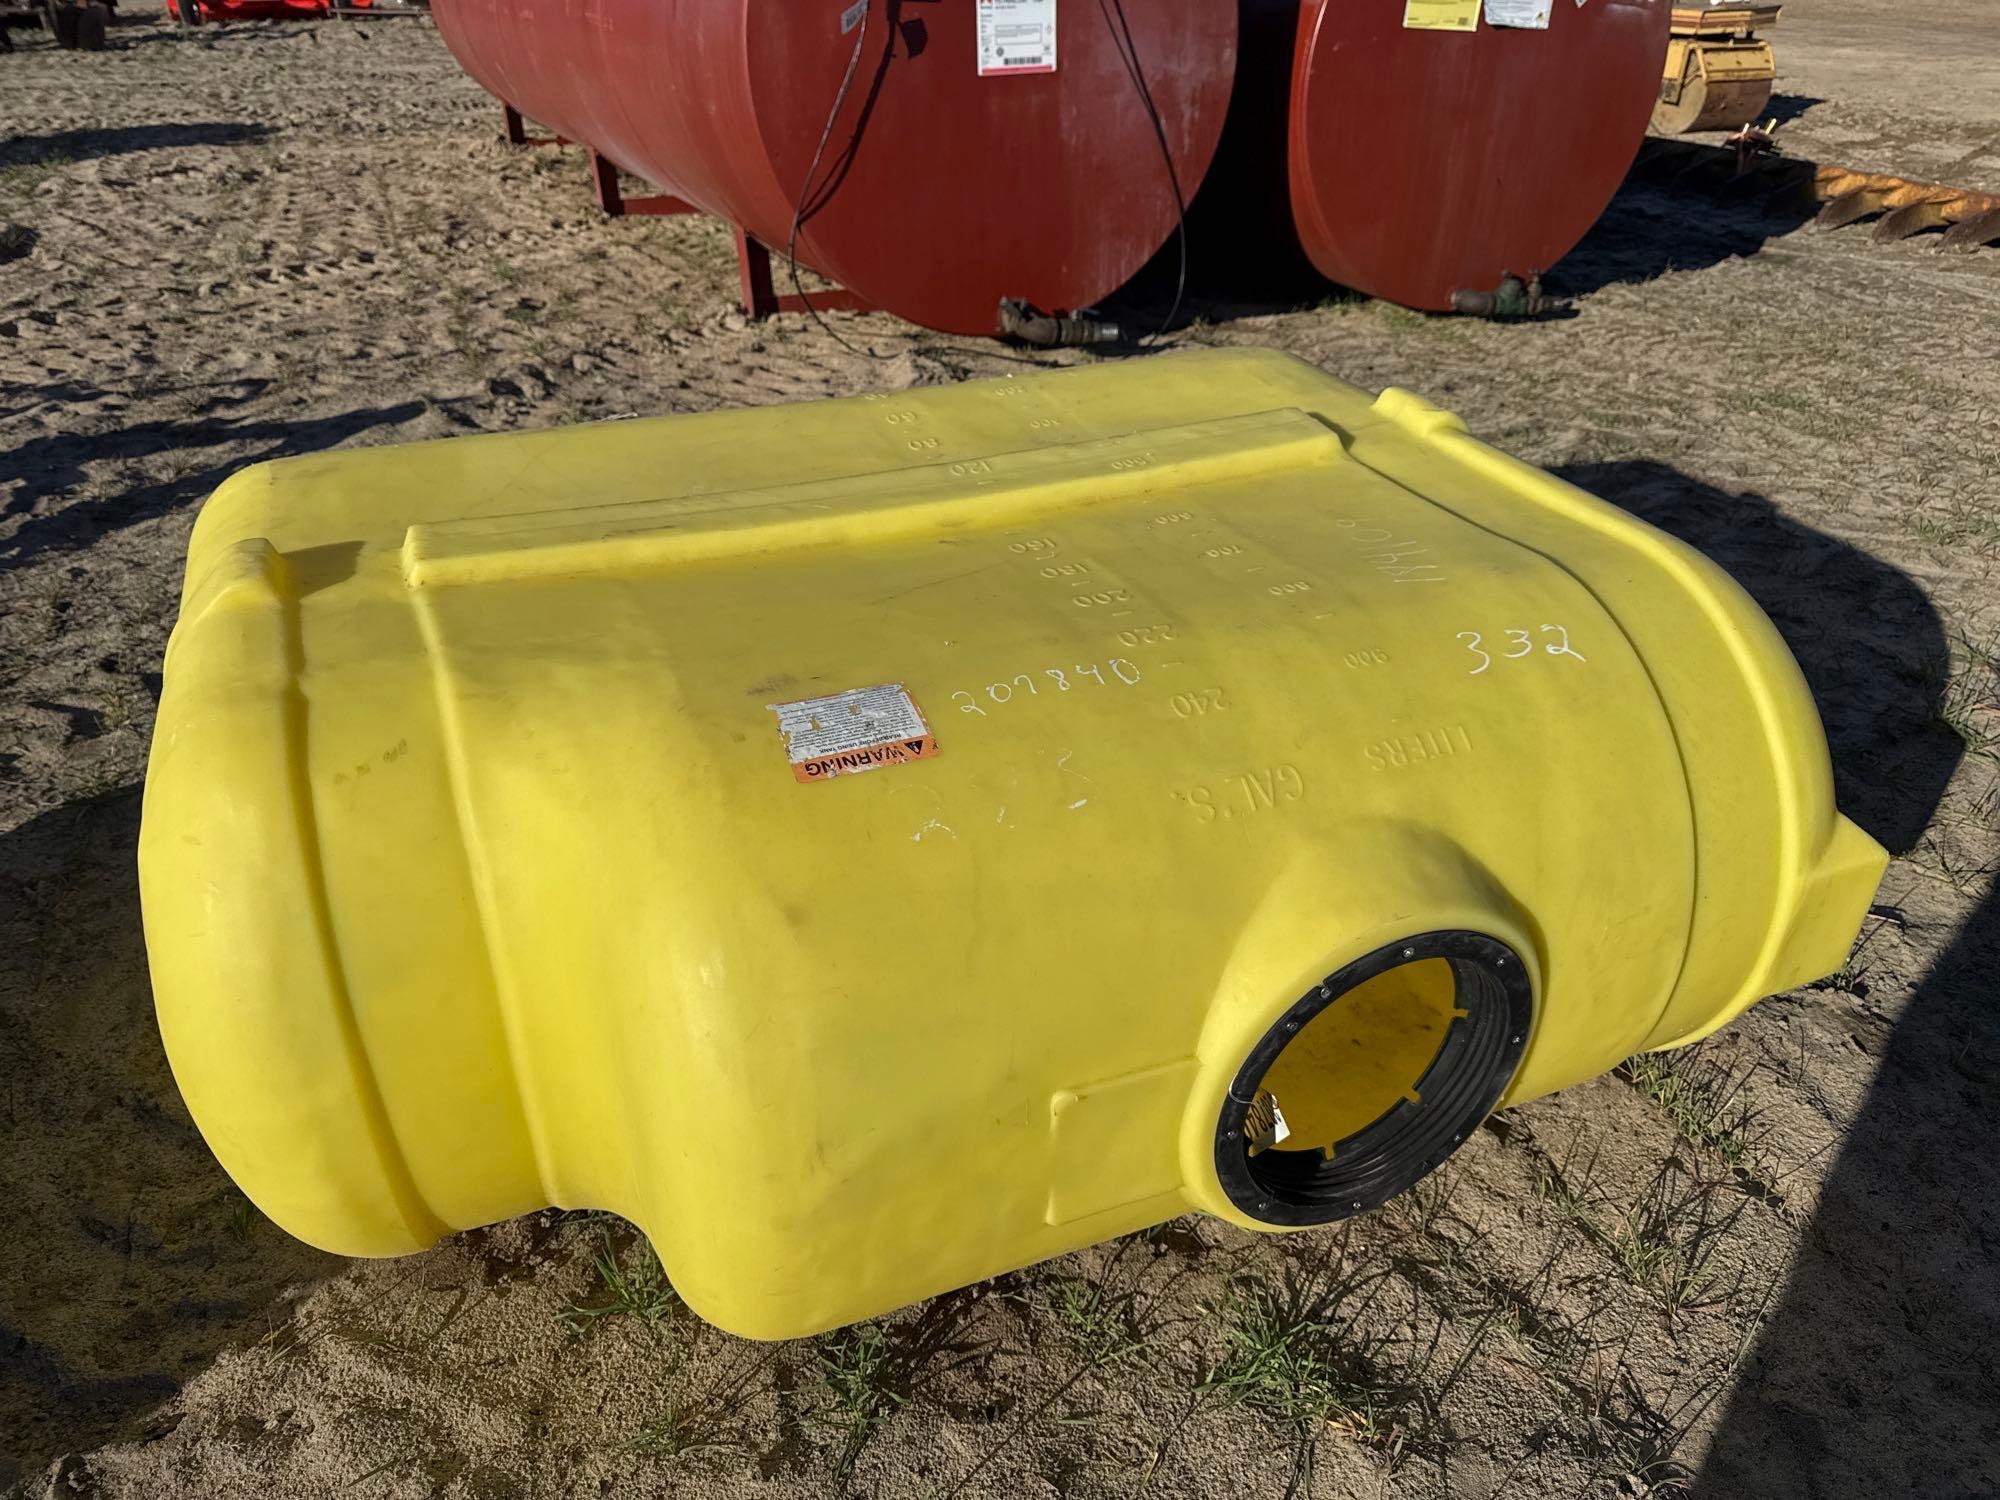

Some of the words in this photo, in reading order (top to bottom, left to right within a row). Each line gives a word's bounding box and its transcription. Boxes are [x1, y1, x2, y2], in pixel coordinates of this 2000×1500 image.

[885, 411, 916, 425] 60
[907, 437, 938, 451] 80
[951, 460, 993, 477] 120
[1008, 537, 1057, 554] 160
[1071, 588, 1132, 608] 200
[1116, 623, 1179, 648] 220
[1343, 648, 1390, 669] 900
[1455, 623, 1587, 675] 332
[950, 658, 1142, 717] 207840
[1169, 686, 1231, 719] 240
[819, 745, 836, 754] TANK
[837, 741, 857, 752] USING
[1363, 725, 1474, 772] LITERS
[805, 744, 904, 777] WARNING
